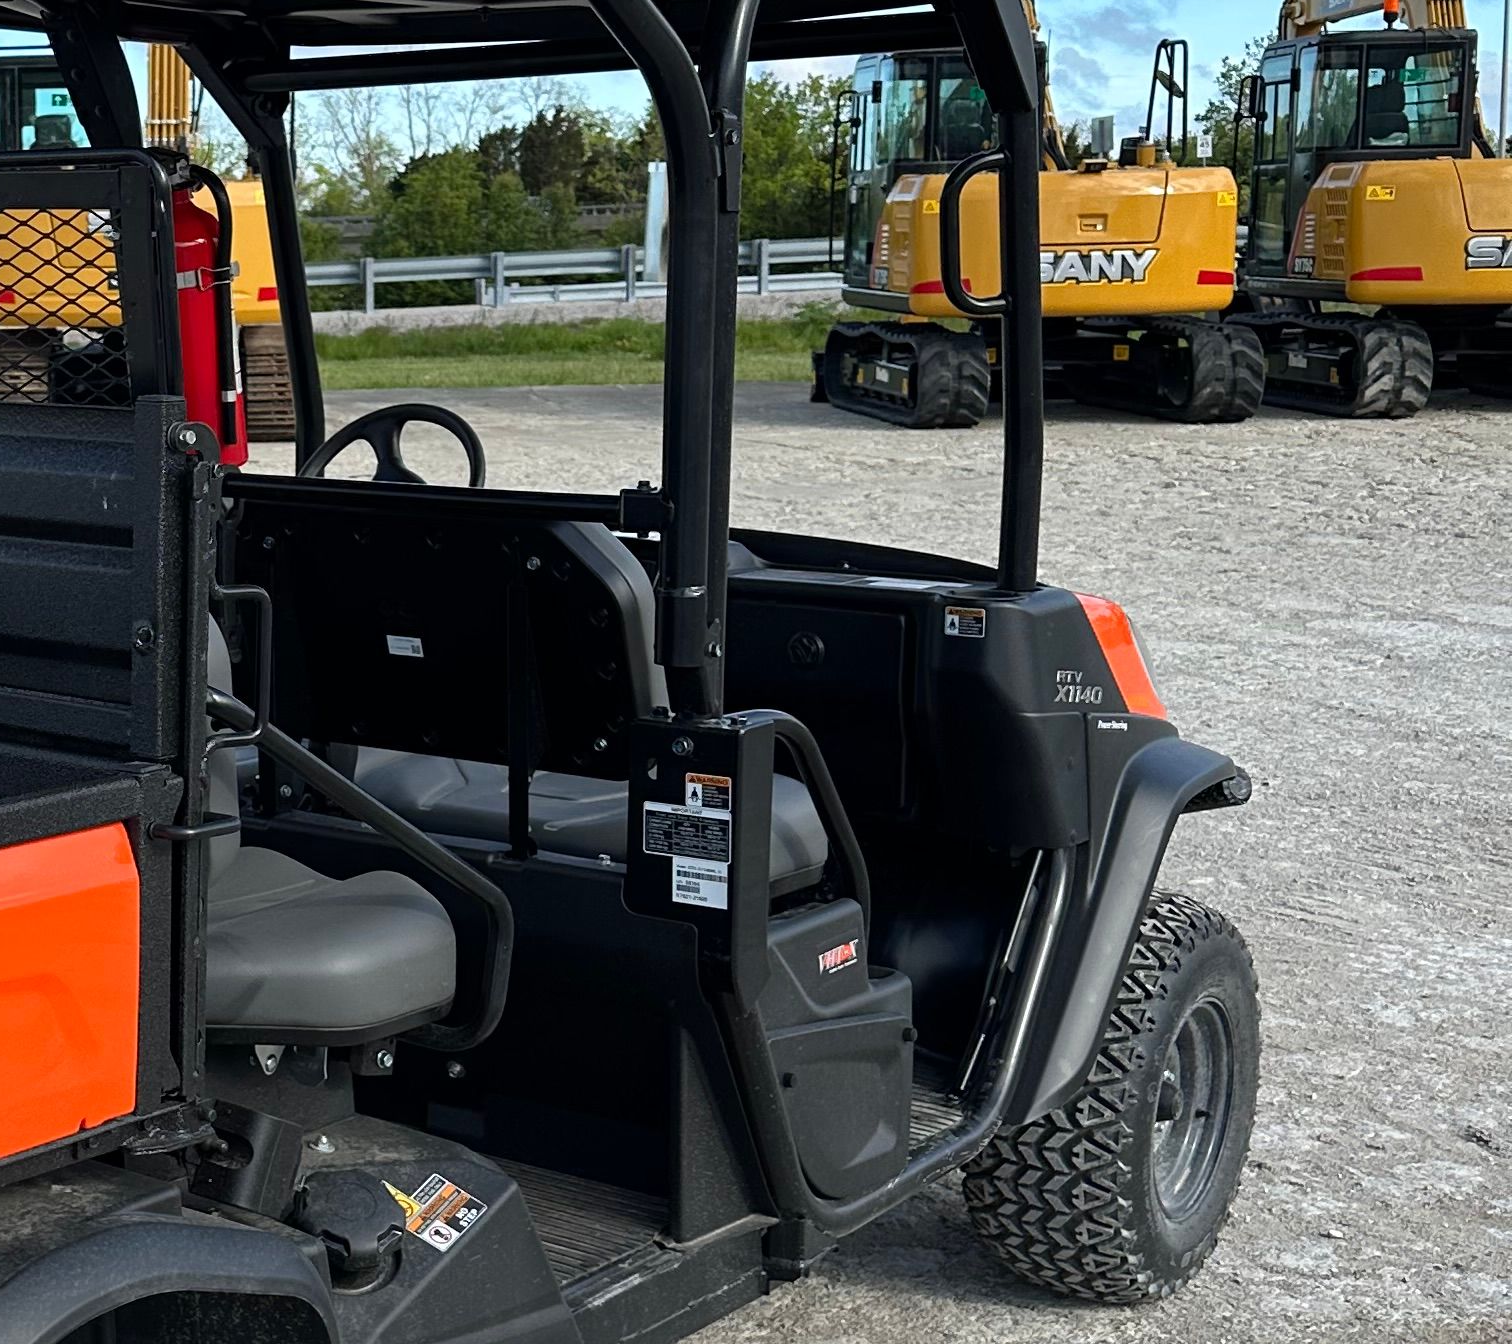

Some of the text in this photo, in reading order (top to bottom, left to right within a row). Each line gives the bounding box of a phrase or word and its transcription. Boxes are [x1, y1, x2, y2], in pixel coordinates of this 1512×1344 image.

[1056, 670, 1083, 683] RTV
[1054, 684, 1104, 705] X1140
[455, 1207, 469, 1220] NO
[459, 1208, 479, 1228] STEP
